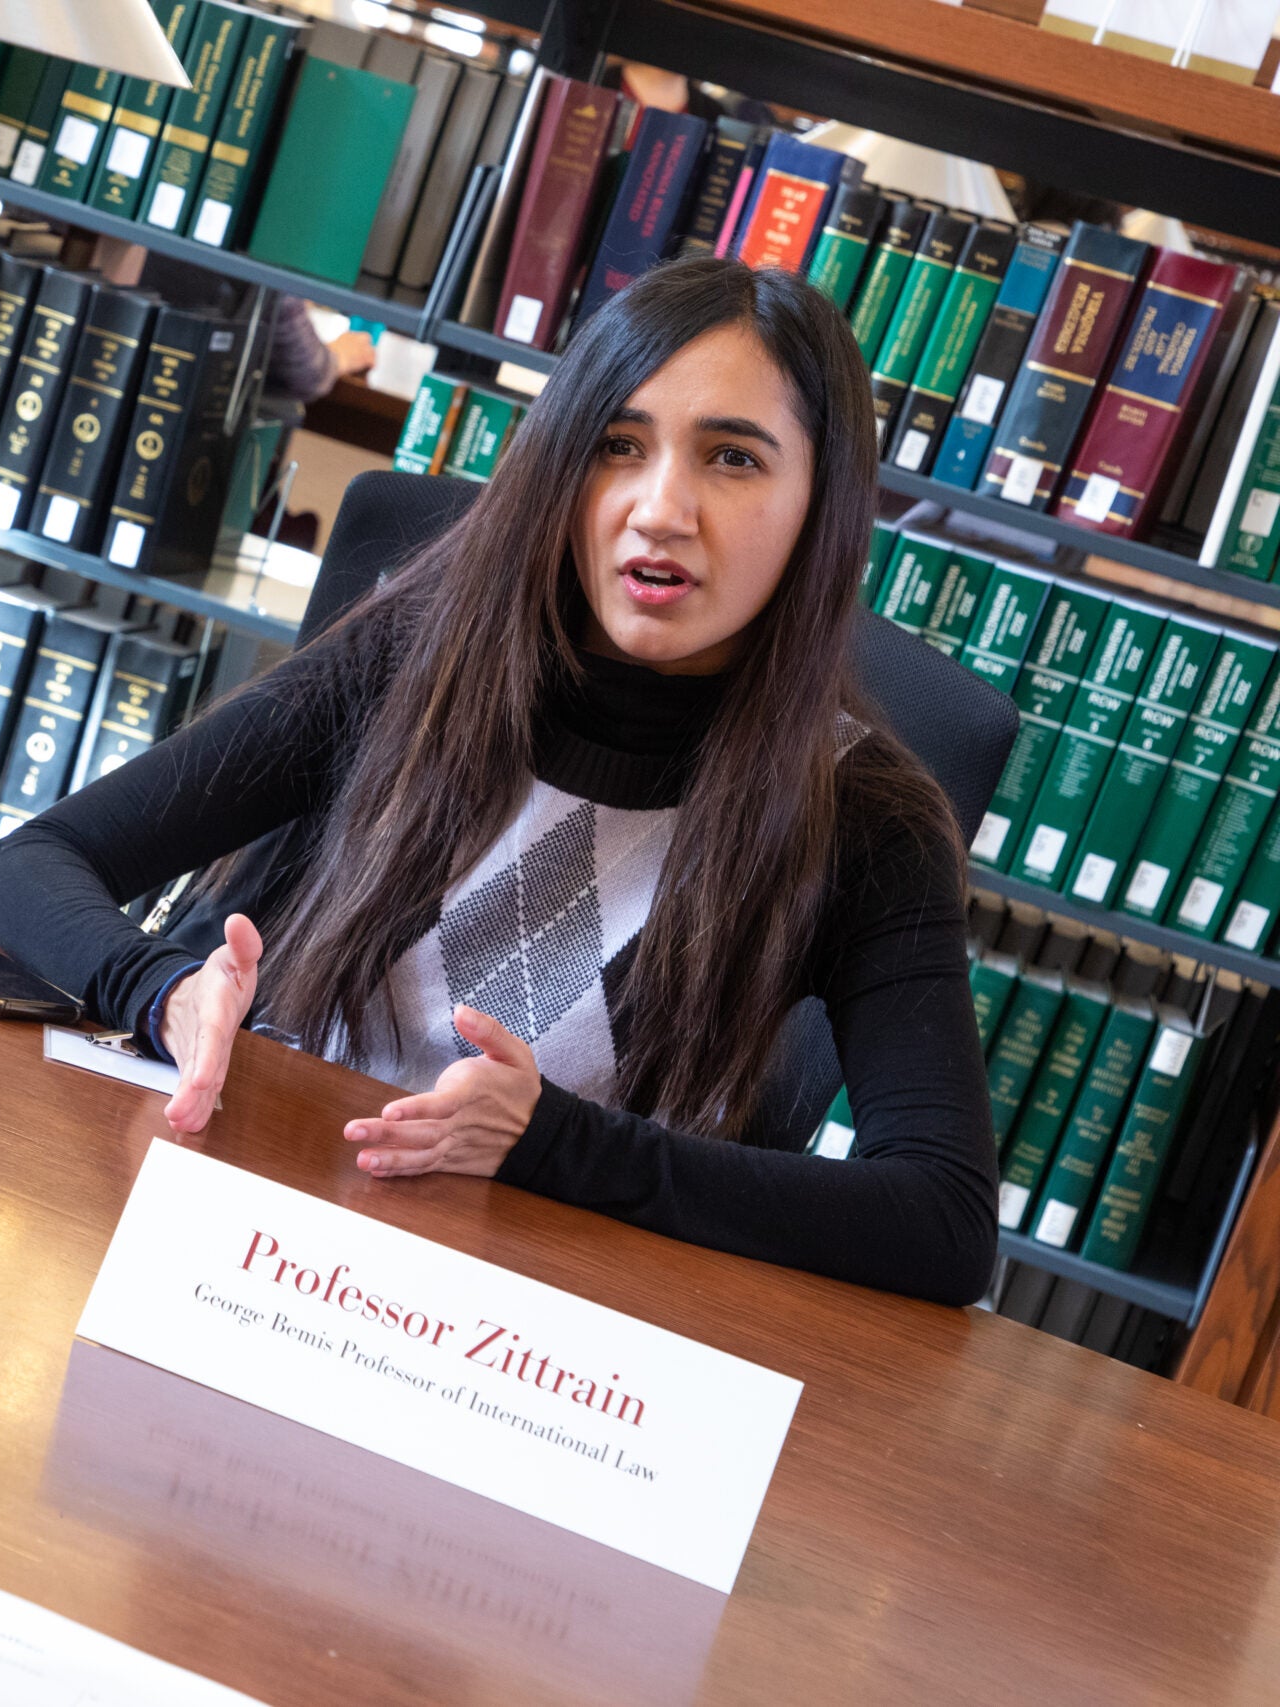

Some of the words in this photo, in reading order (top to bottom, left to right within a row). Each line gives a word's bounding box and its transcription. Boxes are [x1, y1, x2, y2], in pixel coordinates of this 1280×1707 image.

[1071, 291, 1105, 353] VIRGINIA
[928, 565, 961, 629] WASHINGTON
[978, 583, 1012, 649] WASHINGTON
[1037, 600, 1070, 665] WASHINGTON
[1093, 618, 1128, 684] WASHINGTON
[1147, 635, 1183, 701] WASHINGTON
[1199, 651, 1236, 717] WASHINGTON
[237, 1228, 455, 1349] Professor
[464, 1319, 648, 1430] Zittrain
[193, 1281, 265, 1329] George
[271, 1313, 334, 1355] Bemis
[340, 1339, 436, 1394] Professor
[440, 1381, 465, 1404] of
[468, 1391, 610, 1465] International
[613, 1448, 660, 1484] Law
